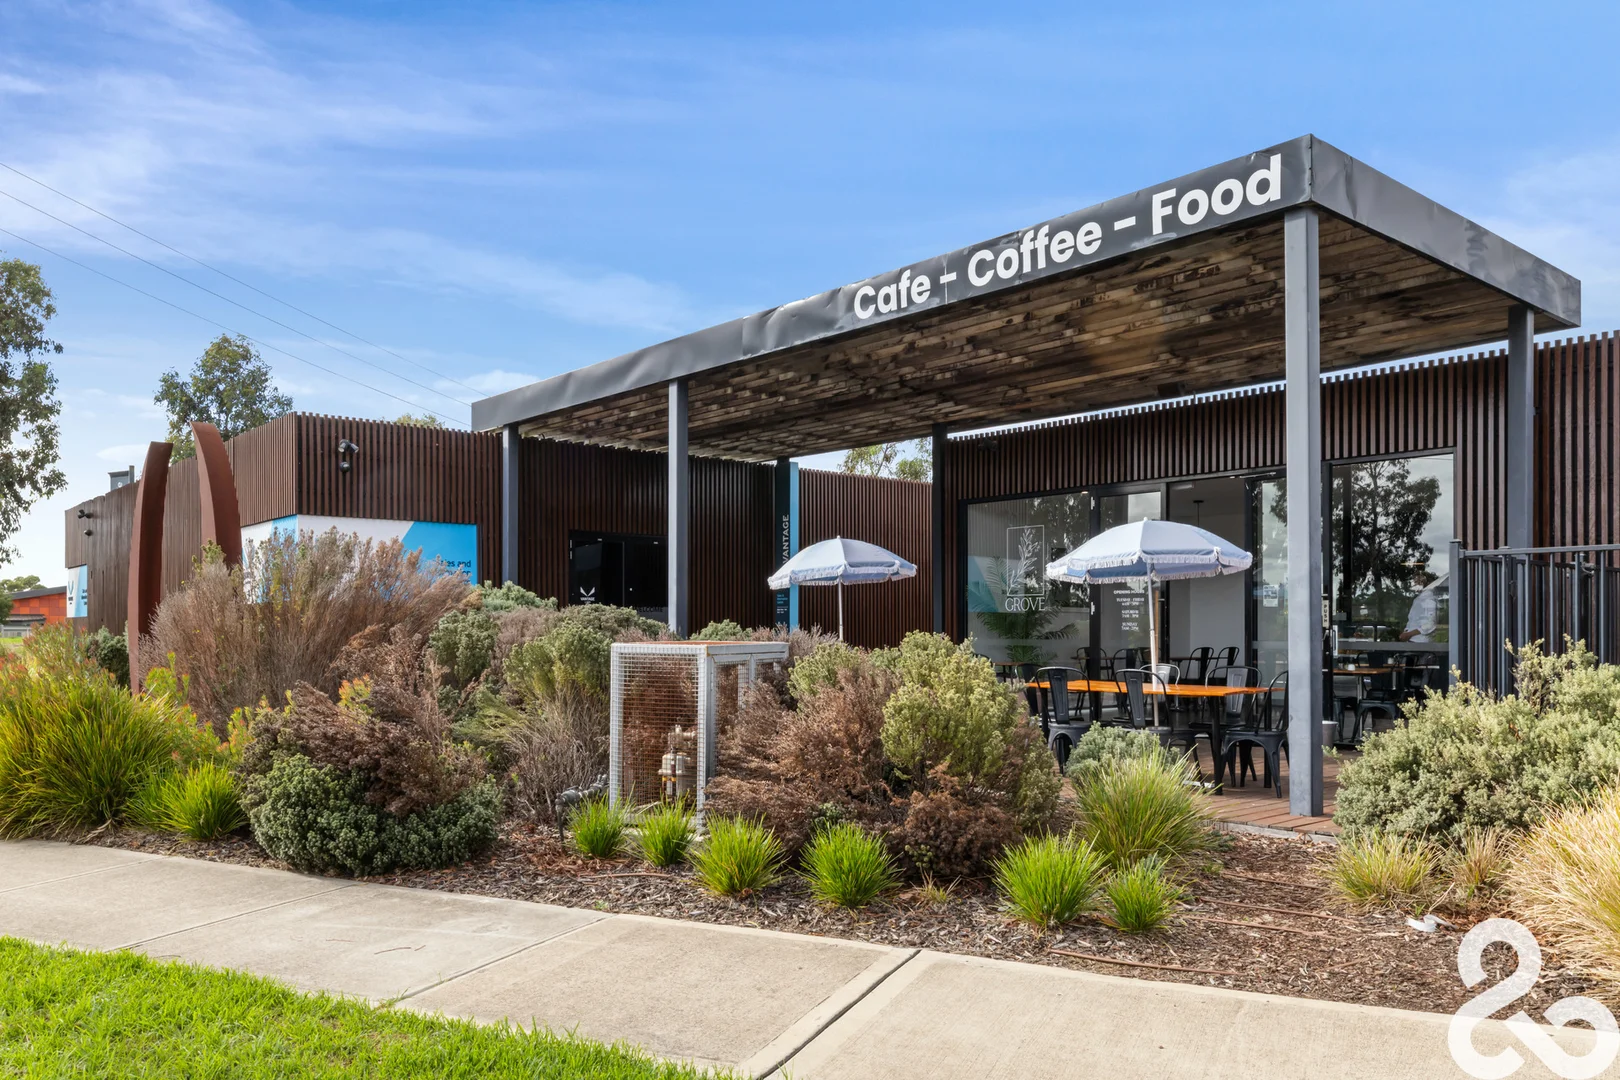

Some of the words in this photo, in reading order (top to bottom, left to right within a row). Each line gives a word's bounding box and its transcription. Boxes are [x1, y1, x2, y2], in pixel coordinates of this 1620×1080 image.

[853, 270, 930, 320] Cafe
[939, 271, 957, 285] -
[967, 221, 1102, 287] Coffee
[1113, 215, 1136, 231] -
[1151, 153, 1282, 236] Food
[1005, 597, 1046, 611] GROVE
